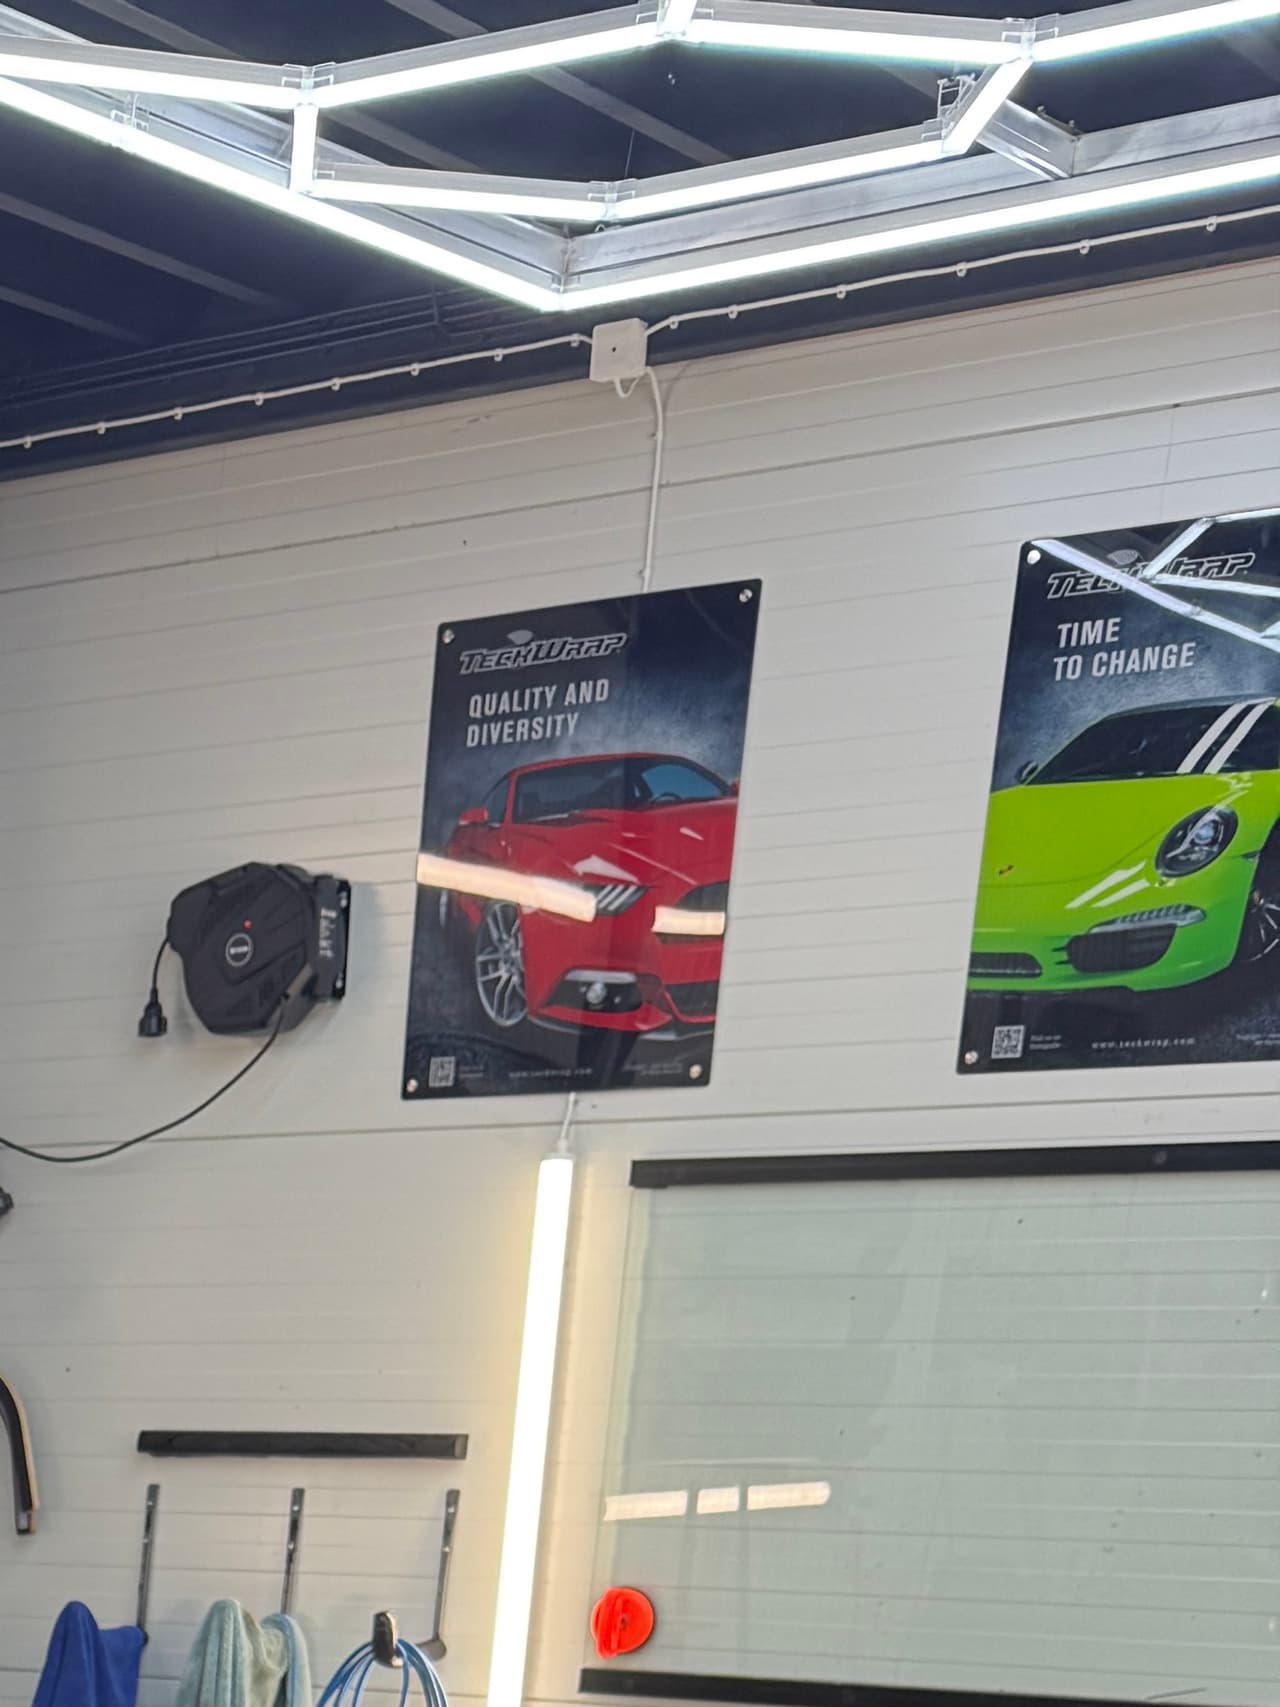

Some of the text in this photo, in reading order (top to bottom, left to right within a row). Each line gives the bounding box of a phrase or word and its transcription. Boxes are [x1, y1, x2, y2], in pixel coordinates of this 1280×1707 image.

[1048, 552, 1256, 599] TECRAP
[1057, 618, 1121, 648] TIME
[1054, 643, 1196, 681] TO CHANGE
[468, 679, 609, 718] QUALITY AND
[466, 713, 580, 747] DIVERSITY
